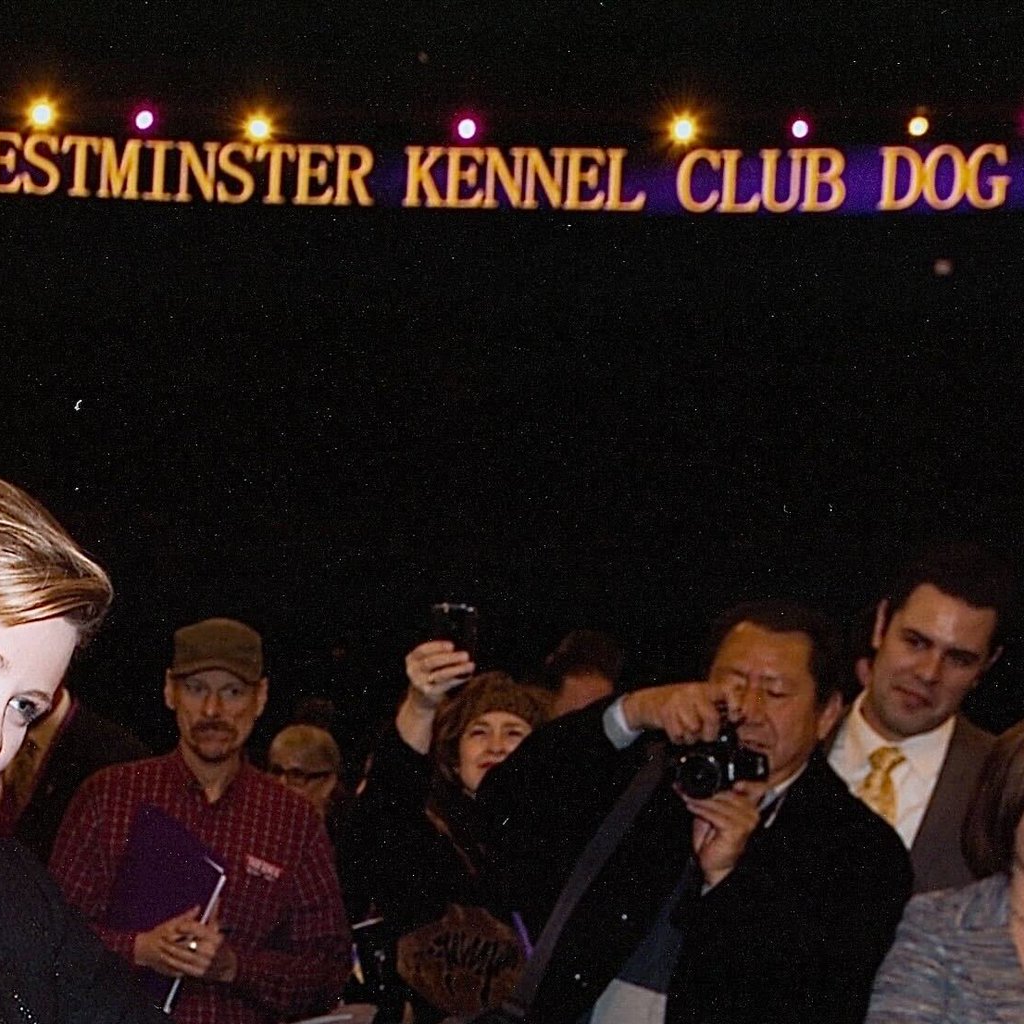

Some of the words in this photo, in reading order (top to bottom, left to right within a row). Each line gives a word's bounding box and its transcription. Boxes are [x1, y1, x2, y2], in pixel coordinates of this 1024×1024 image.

[402, 145, 647, 212] KENNEL
[675, 147, 847, 213] CLUB
[878, 143, 1010, 211] DOG
